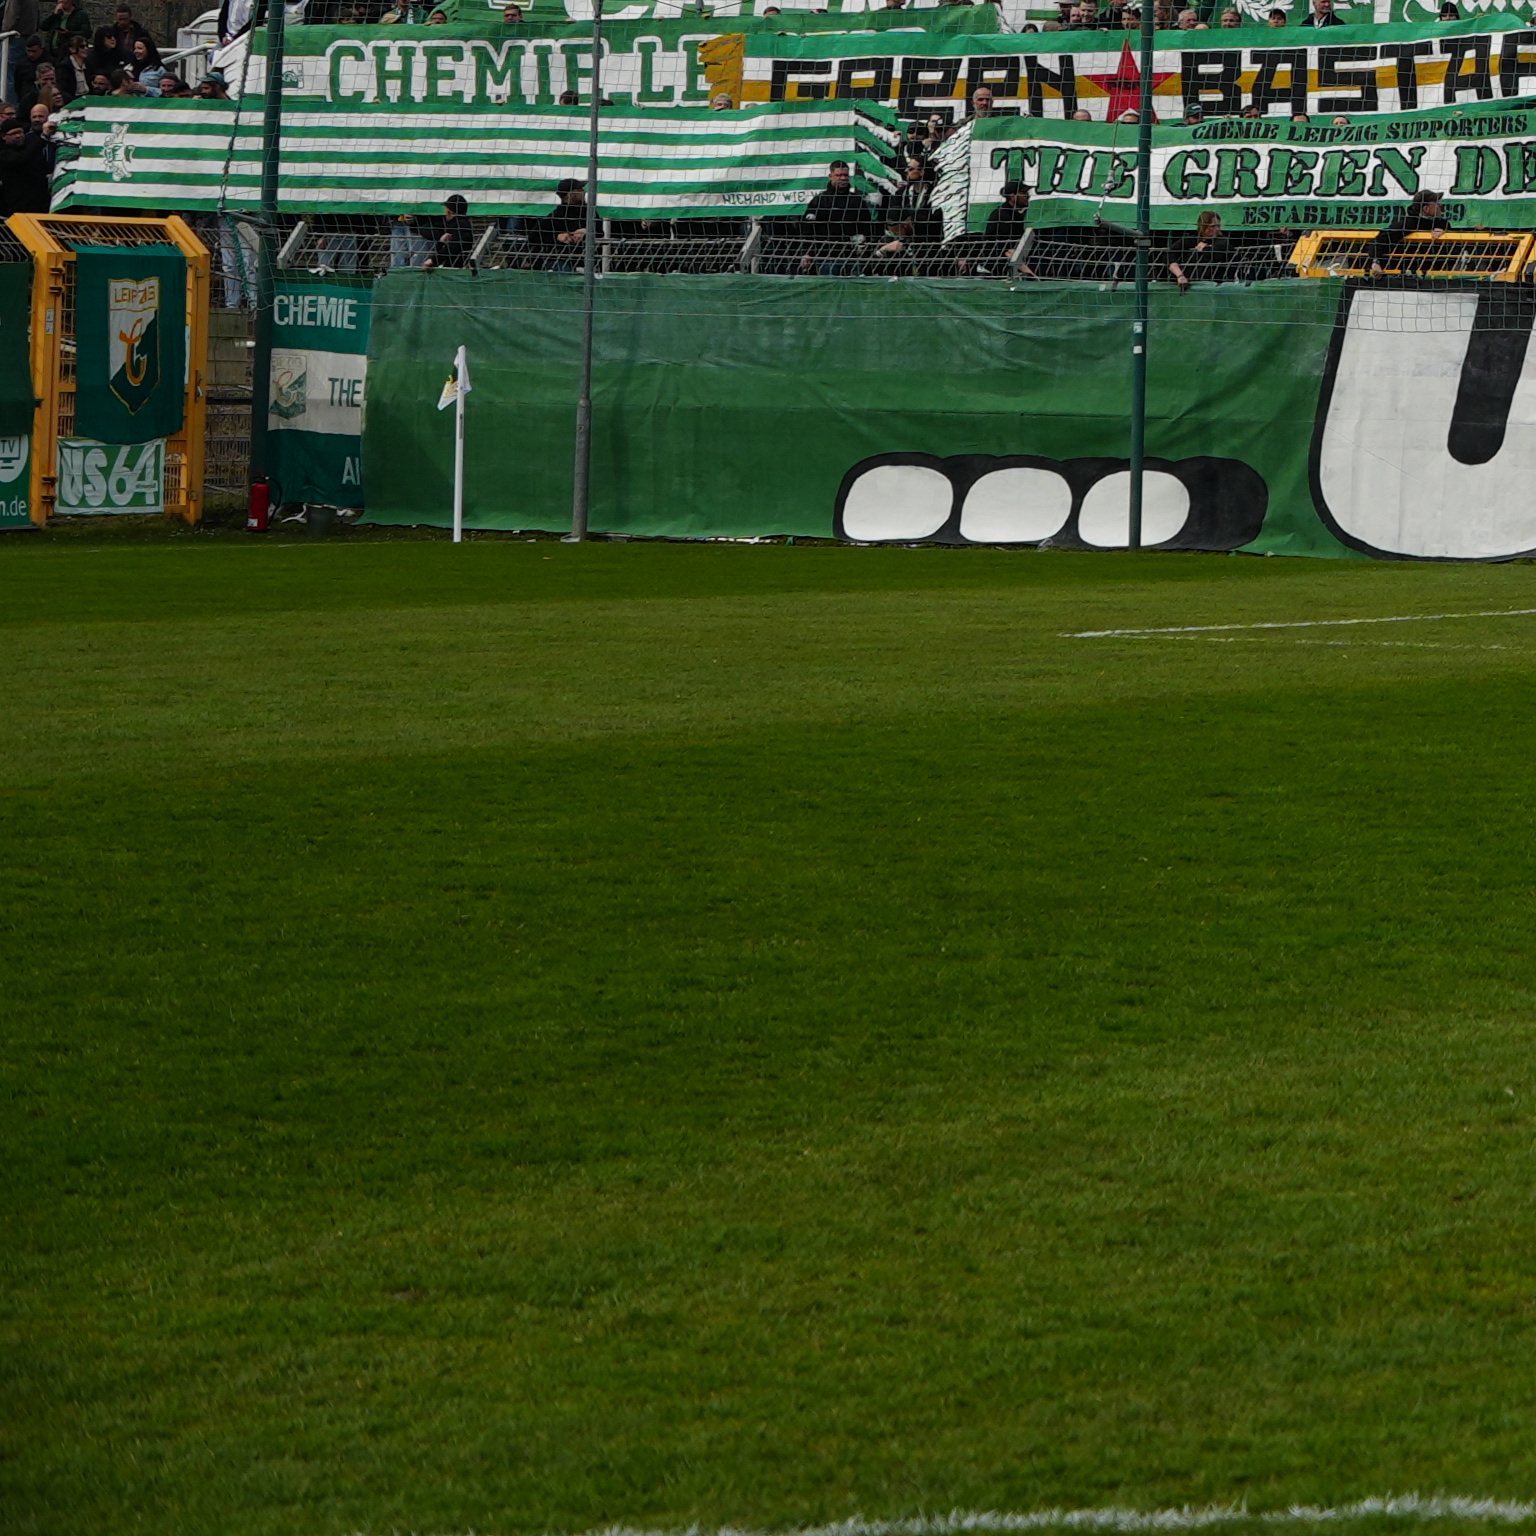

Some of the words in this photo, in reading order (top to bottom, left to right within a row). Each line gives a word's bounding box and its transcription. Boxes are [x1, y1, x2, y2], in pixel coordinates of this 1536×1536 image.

[329, 42, 605, 105] CHEMIE
[1192, 120, 1279, 140] CHEMIE
[1287, 123, 1379, 142] LEIPZIG
[1386, 114, 1528, 140] SUPPORTERS
[991, 145, 1141, 199] THE
[1163, 145, 1427, 199] GREEN
[1243, 205, 1408, 224] ESTABLISHED
[114, 283, 156, 304] LEIPZIG
[273, 295, 357, 331] CHEMIE
[328, 376, 362, 408] THE
